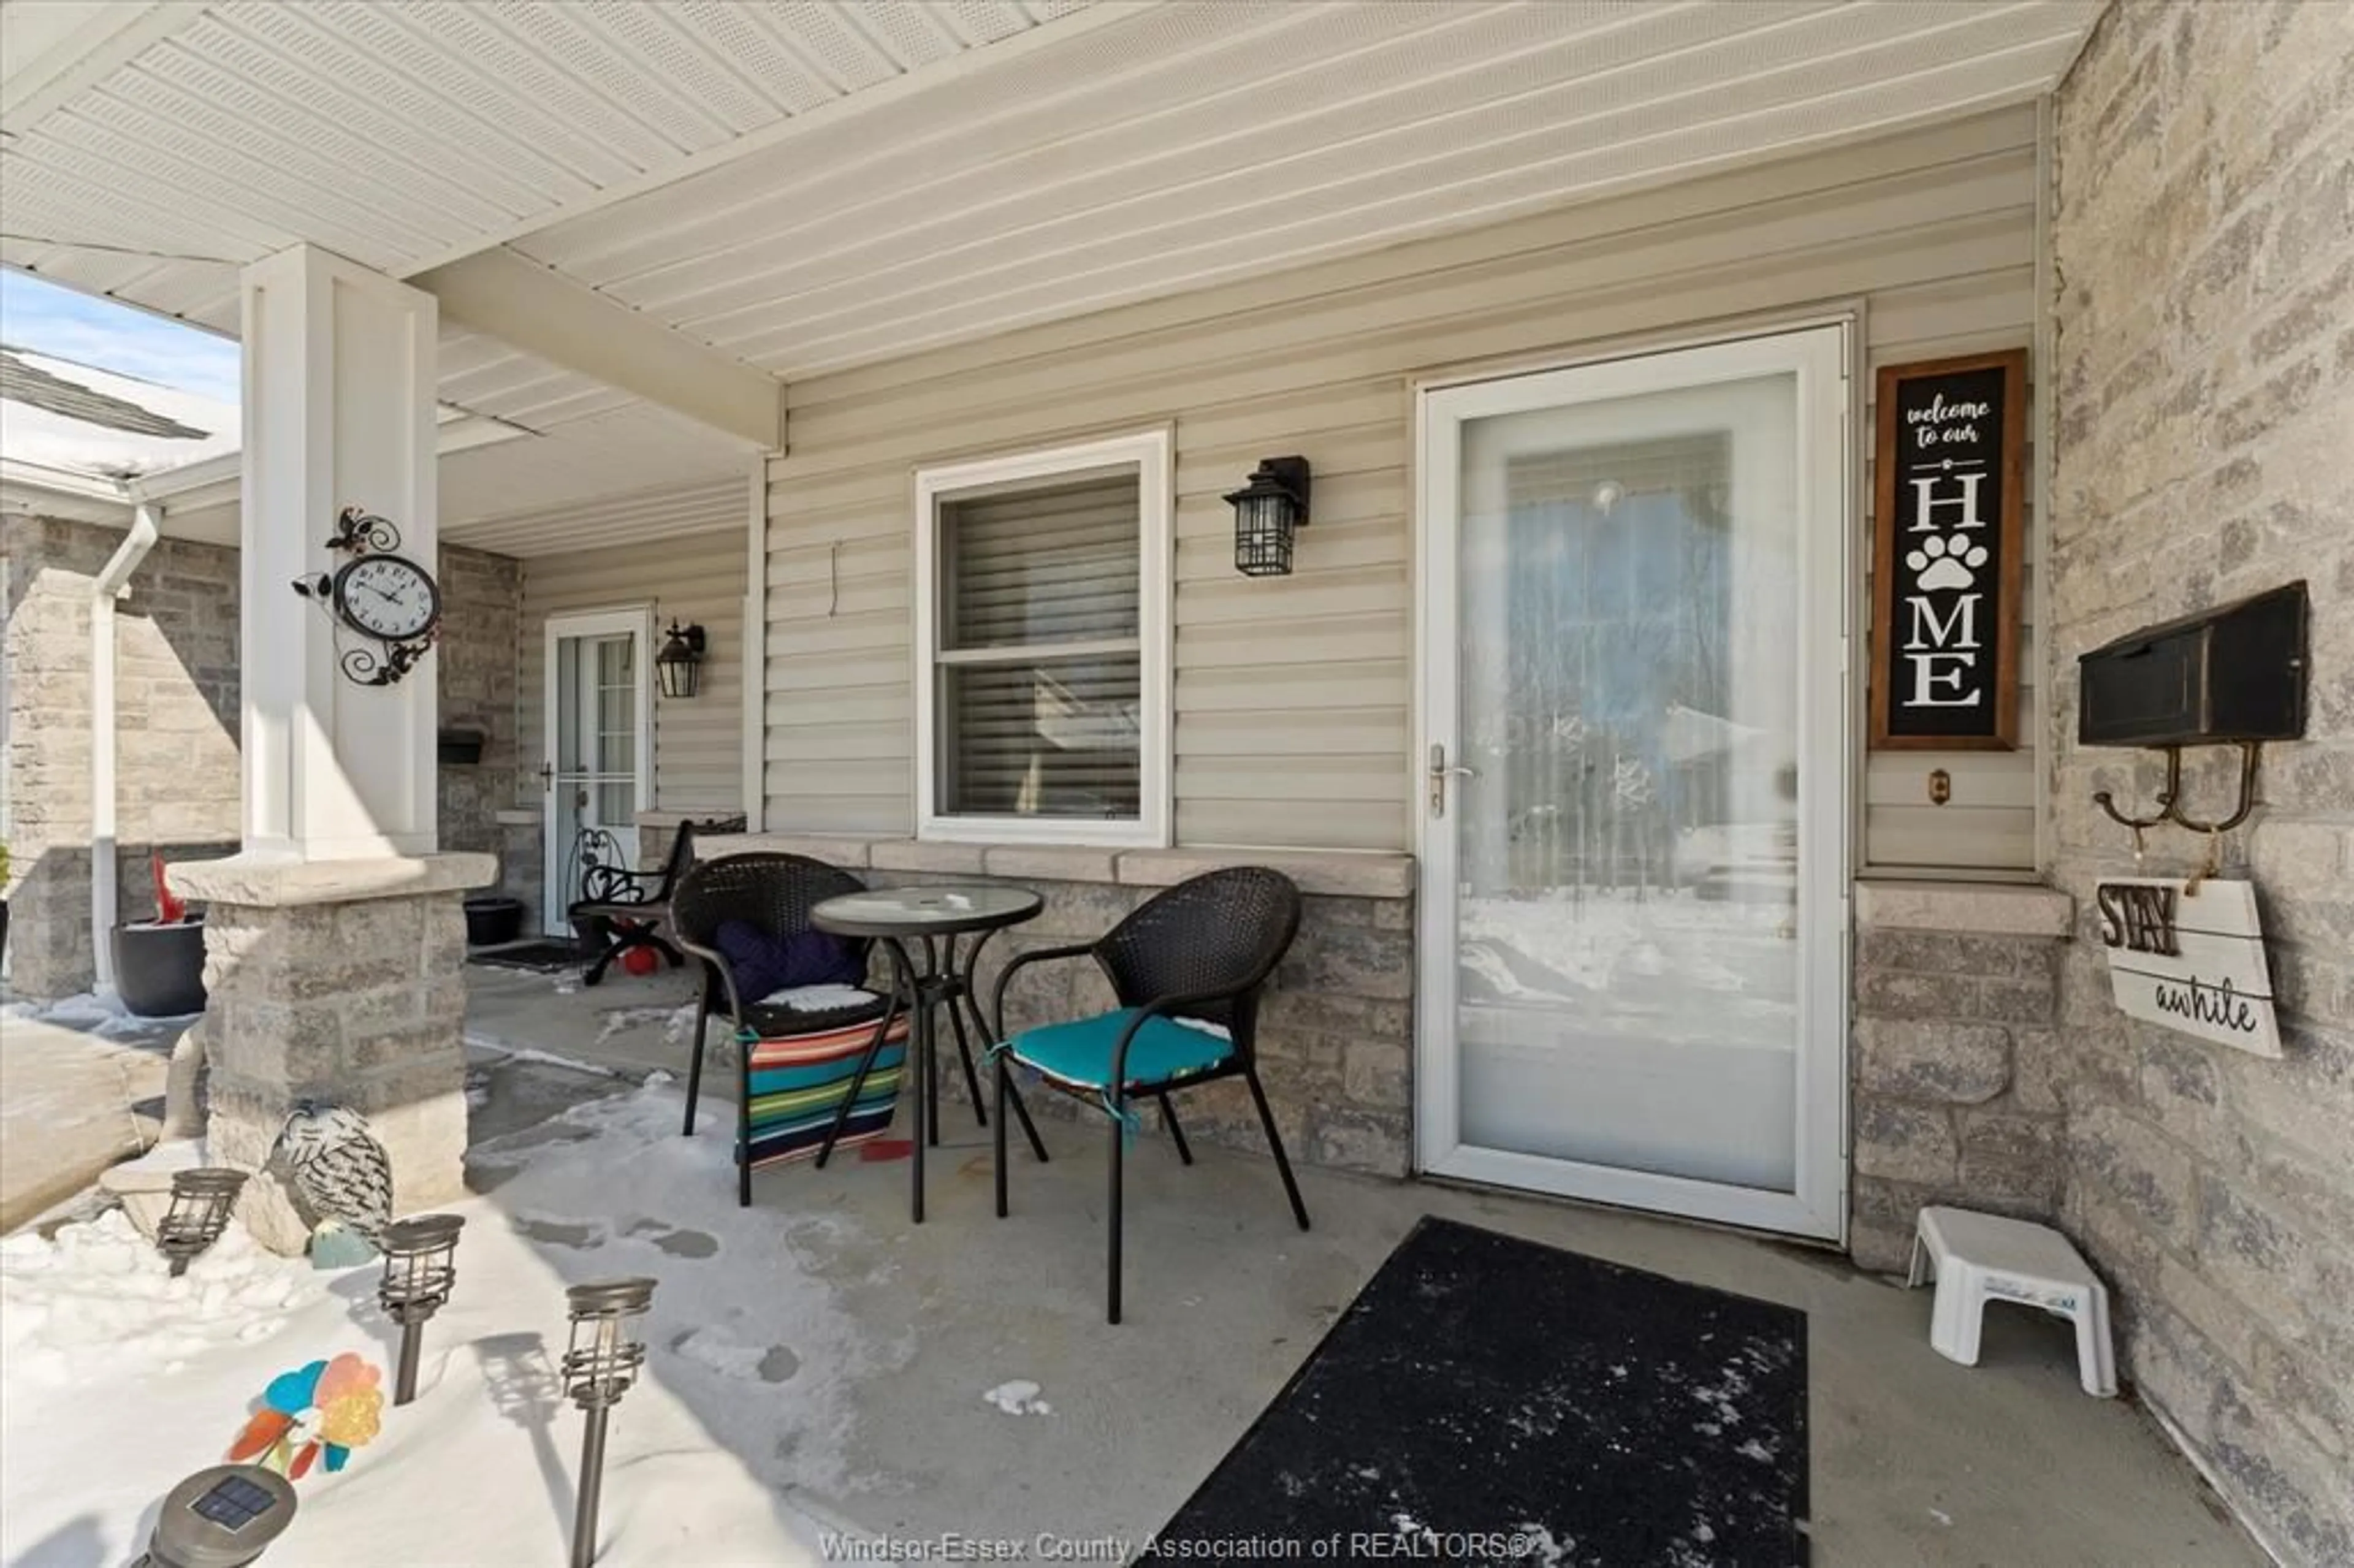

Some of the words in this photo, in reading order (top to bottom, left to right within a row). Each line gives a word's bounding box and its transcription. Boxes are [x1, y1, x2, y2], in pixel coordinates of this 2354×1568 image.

[1907, 392, 1992, 424] welcome
[1916, 425, 1939, 449] to
[1941, 424, 1980, 443] our
[1902, 473, 1988, 707] HME
[2097, 883, 2182, 957] STAY
[2155, 975, 2256, 1032] awhile
